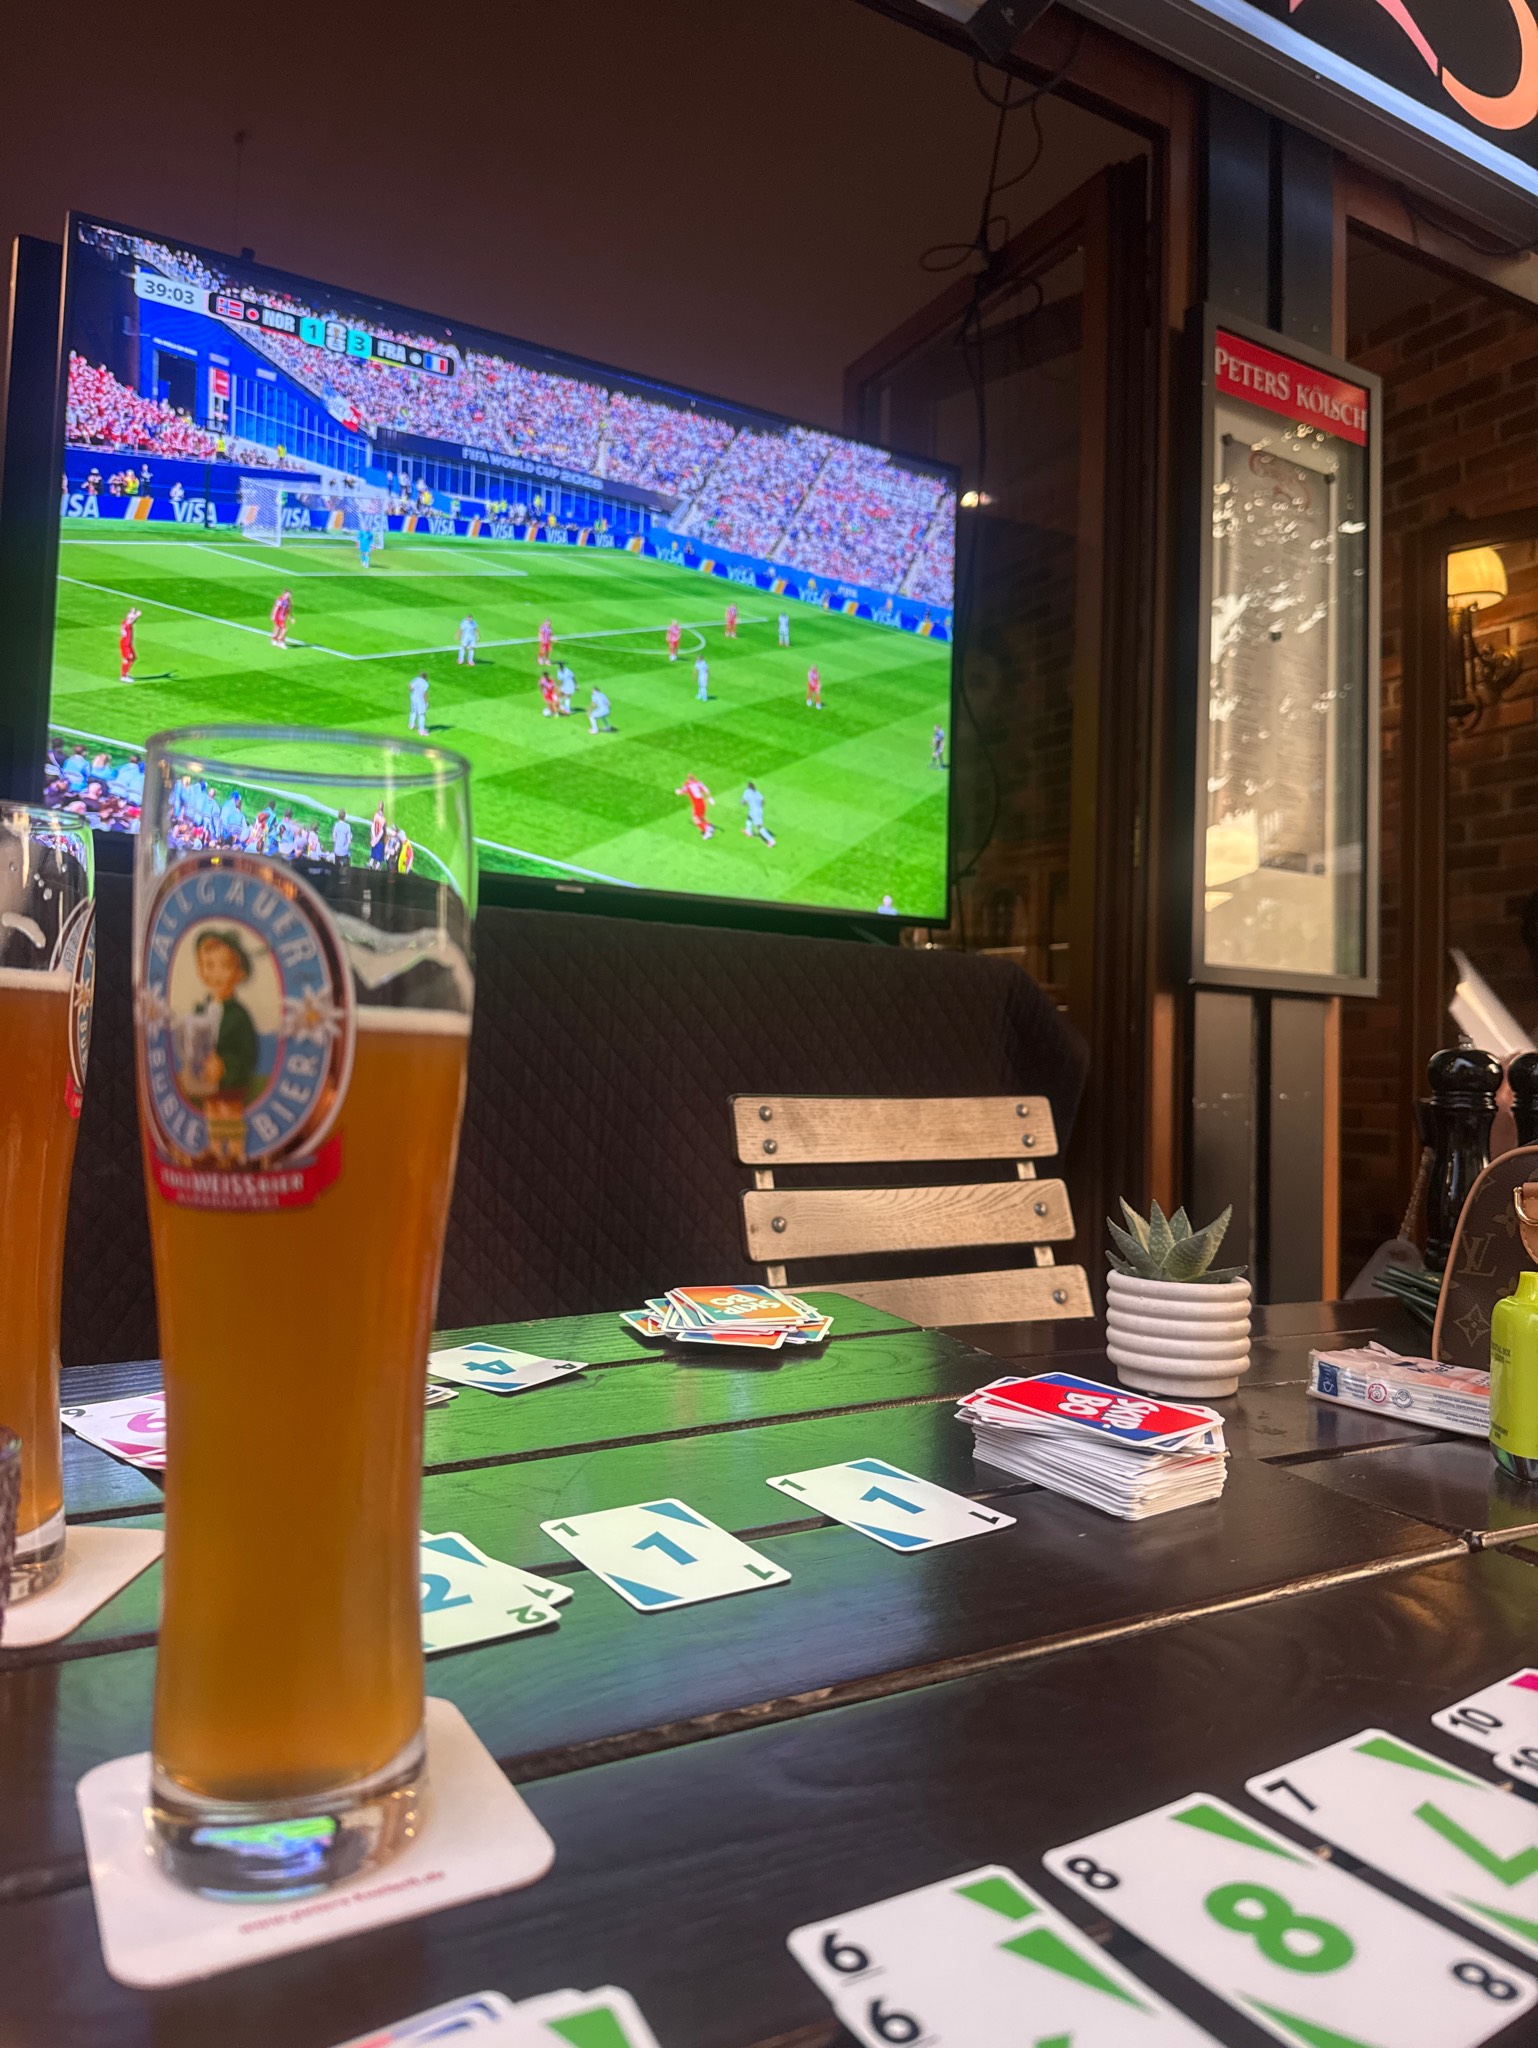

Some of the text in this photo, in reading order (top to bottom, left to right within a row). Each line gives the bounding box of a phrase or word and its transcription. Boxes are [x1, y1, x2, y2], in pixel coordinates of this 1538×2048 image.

[144, 280, 407, 363] 39:03 NOR 1 3 FRA
[1214, 347, 1368, 431] PETERS KÖLSCH
[462, 446, 490, 464] FIFA
[490, 452, 534, 474] WORLD
[535, 462, 560, 480] CUP
[60, 493, 100, 518] ISA
[169, 500, 217, 525] VISA
[428, 517, 456, 535] VISA
[489, 522, 515, 540] VISA
[545, 527, 569, 544] VISA
[251, 1054, 320, 1143] BIER
[462, 1359, 516, 1375] 4
[552, 1362, 577, 1371] 4
[1057, 1391, 1113, 1417] BO
[778, 1478, 807, 1492] 1
[859, 1485, 926, 1515] 1
[551, 1521, 580, 1537] 1
[968, 1510, 1000, 1525] 1
[631, 1531, 699, 1566] 1
[743, 1563, 777, 1581] 1
[421, 1573, 474, 1615] 2
[506, 1604, 548, 1624] 2
[1448, 1707, 1504, 1735] 10
[1262, 1776, 1318, 1812] 7
[1065, 1857, 1120, 1890] 8
[1203, 1881, 1356, 1975] 8
[820, 1930, 870, 1974] 6
[1452, 1962, 1520, 2002] 8
[869, 1996, 920, 2045] 6
